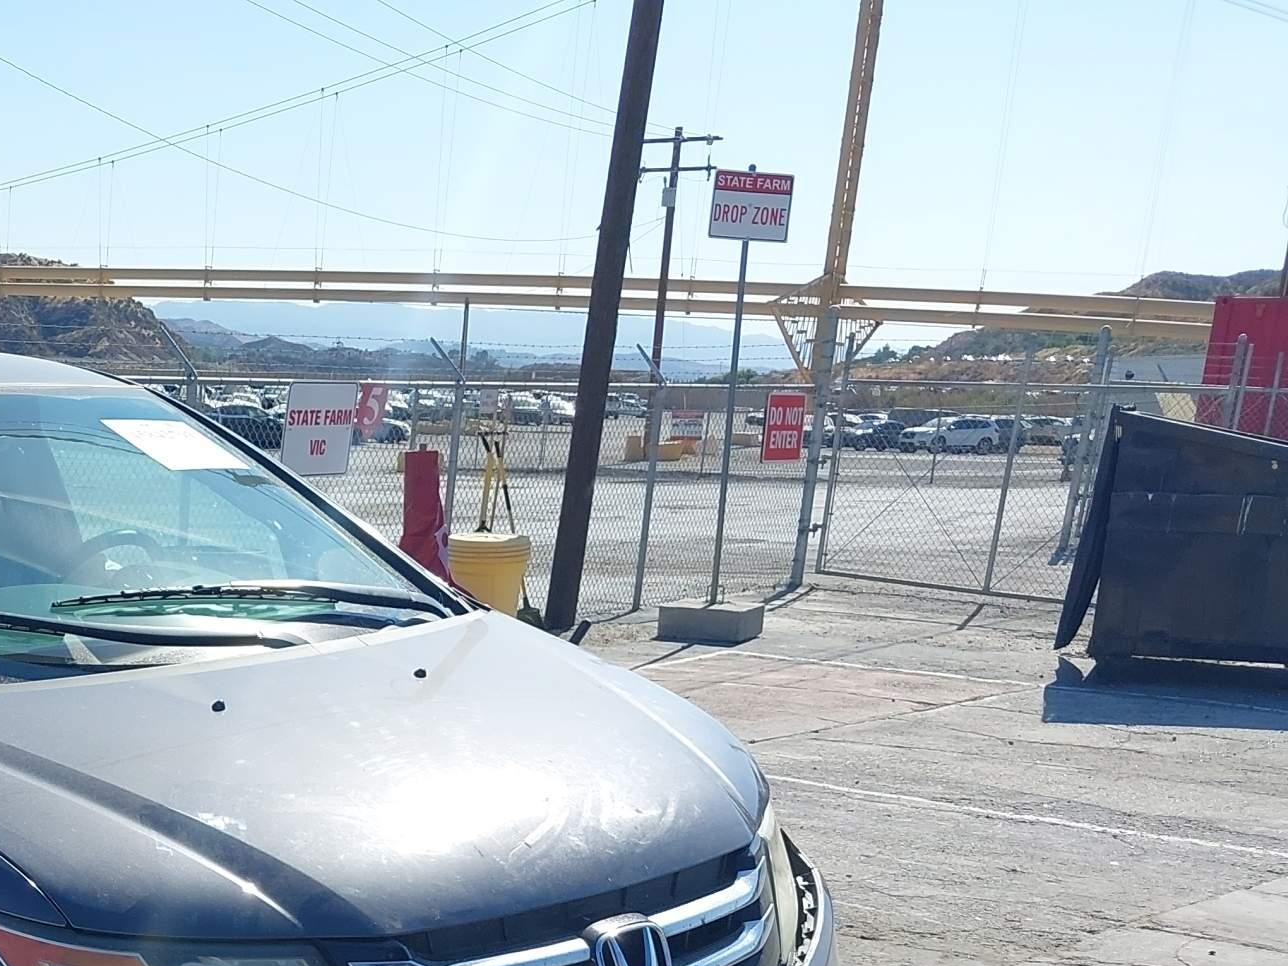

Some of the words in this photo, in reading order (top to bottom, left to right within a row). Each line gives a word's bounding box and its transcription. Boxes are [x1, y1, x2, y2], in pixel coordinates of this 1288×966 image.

[717, 174, 754, 189] STATE
[756, 178, 791, 191] FARM
[713, 203, 748, 224] DROP
[751, 206, 787, 227] ZONE
[363, 387, 384, 425] 5
[288, 409, 322, 426] STATE
[323, 409, 352, 425] FARM
[769, 406, 783, 426] DO
[784, 407, 804, 426] NOT
[309, 439, 326, 456] VIC
[769, 430, 799, 449] ENTER
